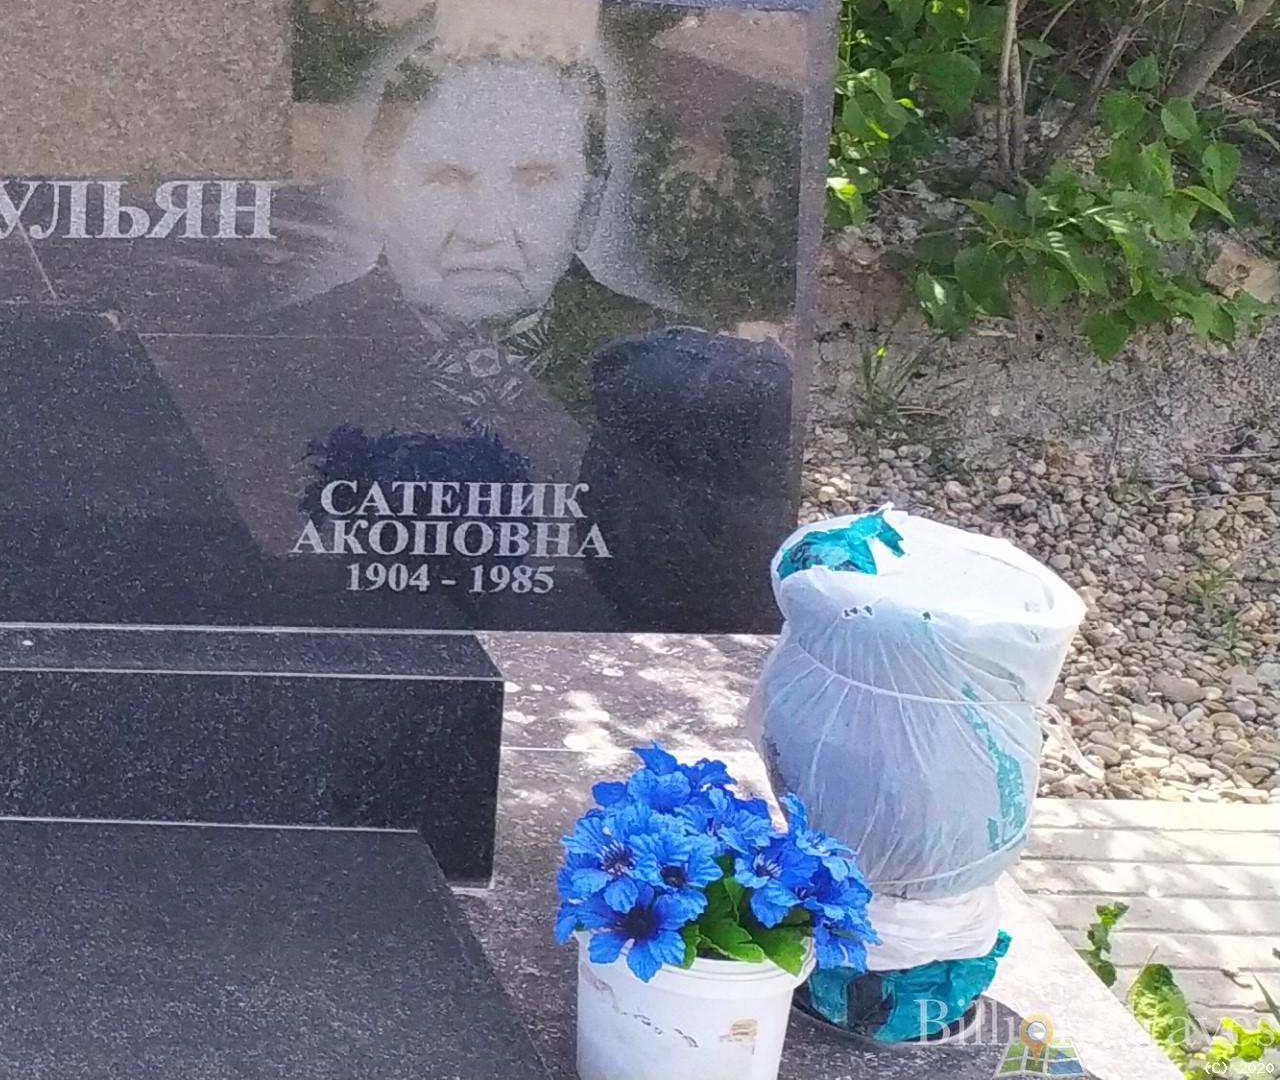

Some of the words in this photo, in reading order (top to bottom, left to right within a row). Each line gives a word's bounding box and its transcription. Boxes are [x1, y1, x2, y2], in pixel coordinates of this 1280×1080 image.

[319, 479, 591, 519] САТЕНИК
[289, 518, 614, 559] АКОПОВНА
[345, 562, 431, 593] 1904
[469, 564, 556, 594] 1985
